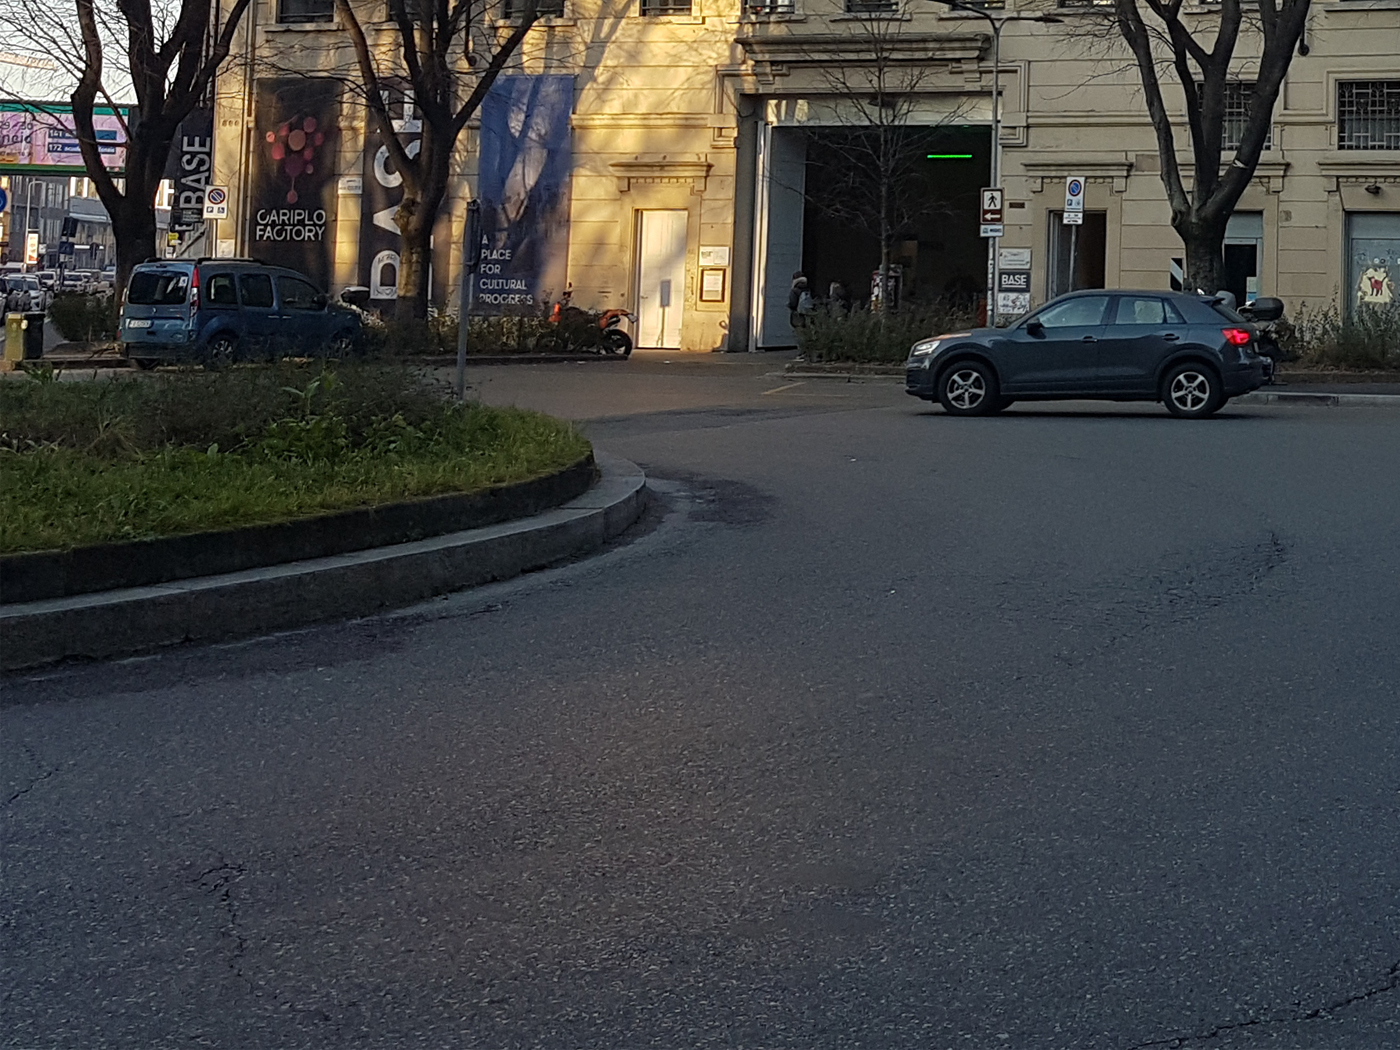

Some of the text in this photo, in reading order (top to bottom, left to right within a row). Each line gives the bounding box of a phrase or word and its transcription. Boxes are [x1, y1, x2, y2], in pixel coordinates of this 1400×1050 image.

[179, 136, 211, 209] BASE
[257, 209, 326, 225] CARIPLO
[256, 226, 325, 241] FACTORY
[481, 234, 489, 245] A
[481, 249, 512, 261] PLACE
[480, 264, 501, 275] FOR
[480, 278, 527, 290] CULTURAL
[1001, 274, 1027, 285] BASE
[479, 293, 534, 305] PROGRESS
